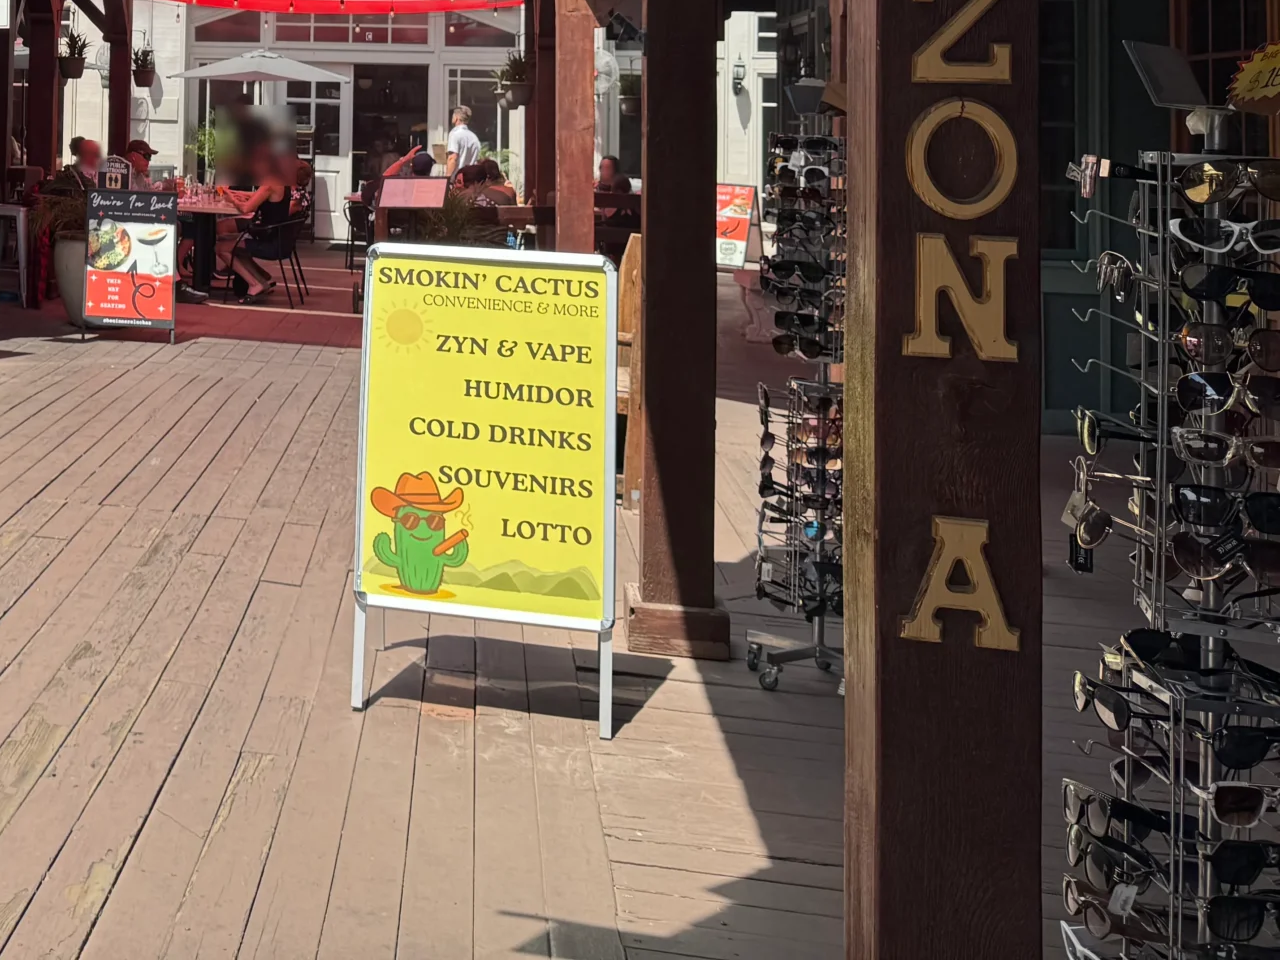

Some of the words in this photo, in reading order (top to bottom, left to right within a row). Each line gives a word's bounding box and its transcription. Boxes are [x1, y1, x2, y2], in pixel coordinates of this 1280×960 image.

[129, 194, 145, 209] In
[150, 195, 174, 210] Luck
[378, 266, 488, 291] SMOKIN'
[495, 274, 600, 299] CACTUS
[422, 293, 533, 314] CONVENIENCE
[536, 301, 550, 315] &
[553, 302, 599, 318] MORE
[436, 334, 489, 356] ZYN
[497, 339, 519, 358] &
[525, 342, 593, 365] VAPE
[463, 379, 594, 408] HUMIDOR
[409, 416, 480, 441] COLD
[488, 424, 592, 452] DRINKS
[438, 464, 593, 499] SOUVENIRS
[501, 518, 593, 546] LOTTO
